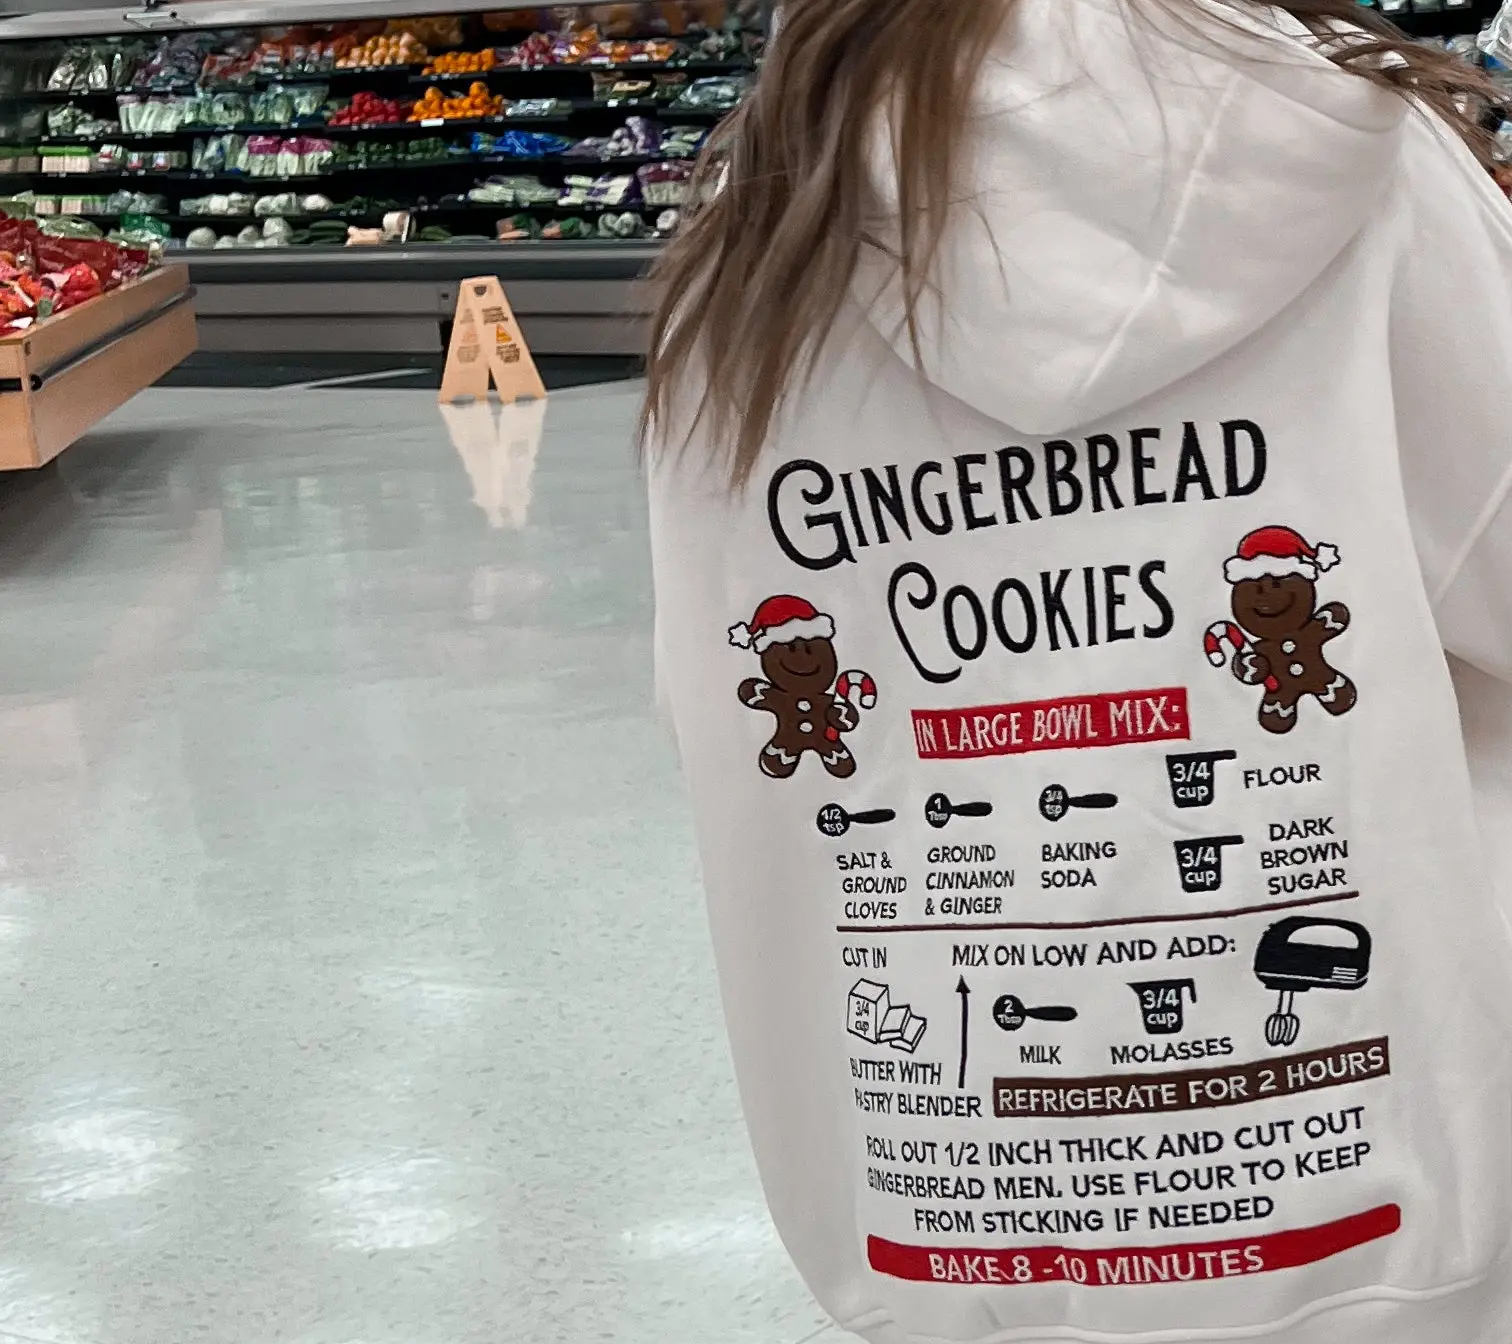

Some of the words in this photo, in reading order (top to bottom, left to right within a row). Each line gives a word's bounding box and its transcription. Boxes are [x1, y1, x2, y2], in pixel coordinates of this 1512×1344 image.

[766, 418, 1269, 570] GINGERBREAD
[887, 560, 1174, 683] COOKIES
[915, 718, 938, 753] IN
[941, 711, 1023, 752] LARGE
[1031, 704, 1098, 742] BOWL
[1107, 695, 1181, 738] MIX:
[1172, 761, 1211, 784] 3/4
[1243, 763, 1322, 789] FLOUR
[933, 797, 942, 810] 1
[1175, 786, 1209, 802] cup
[821, 808, 843, 822] 1/2
[823, 822, 845, 834] tsp
[1268, 816, 1335, 843] DARK
[836, 851, 877, 871] SALT
[880, 851, 893, 869] &
[926, 844, 996, 864] GROUND
[1041, 840, 1118, 863] BAKING
[1179, 845, 1218, 869] 3/4
[1260, 840, 1349, 870] BROWN
[842, 876, 908, 894] GROUND
[925, 869, 1015, 891] CINNAMON
[1041, 868, 1098, 890] SODA
[1184, 870, 1217, 887] cup
[1267, 868, 1347, 896] SUGAR
[844, 901, 897, 920] CLOVES
[924, 897, 935, 916] &
[940, 896, 1002, 916] GINGER
[842, 946, 869, 968] CUT
[872, 946, 888, 969] IN
[952, 943, 989, 967] MIX
[994, 944, 1025, 967] ON
[1032, 943, 1089, 968] LOW
[1096, 939, 1157, 966] AND
[1166, 934, 1236, 960] ADD:
[855, 999, 870, 1018] 3/4
[1004, 998, 1015, 1013] 2
[1141, 987, 1181, 1010] 3/4
[854, 1019, 870, 1036] cup
[1146, 1012, 1179, 1028] cup
[1020, 1045, 1062, 1066] MILK
[1110, 1037, 1234, 1065] MOLASSES
[850, 1056, 896, 1082] BUTTER
[899, 1059, 943, 1086] WITH
[997, 1083, 1178, 1112] REFRIGERATE
[1189, 1075, 1249, 1104] FOR
[1257, 1069, 1277, 1094] 2
[1286, 1045, 1386, 1090] HOURS
[897, 1093, 983, 1118] BLENDER
[866, 1134, 897, 1162] ROLL
[901, 1141, 938, 1166] OUT
[945, 1141, 981, 1167] 1/2
[988, 1138, 1053, 1167] INCH
[1059, 1135, 1149, 1164] THICK
[1155, 1130, 1225, 1161] AND
[1233, 1119, 1295, 1150] CUT
[1304, 1106, 1366, 1140] OUT
[866, 1166, 986, 1200] GINGERBREAD
[993, 1174, 1063, 1200] MEN.
[1071, 1173, 1126, 1198] USE
[1134, 1164, 1237, 1196] FLOUR
[1240, 1158, 1286, 1186] TO
[1294, 1141, 1372, 1178] KEEP
[914, 1207, 976, 1234] FROM
[982, 1209, 1104, 1234] STICKING
[1114, 1207, 1140, 1232] IF
[1148, 1195, 1275, 1230] NEEDED
[928, 1252, 1001, 1283] BAKE
[1010, 1254, 1034, 1283] 8
[1096, 1244, 1266, 1285] MINUTES
